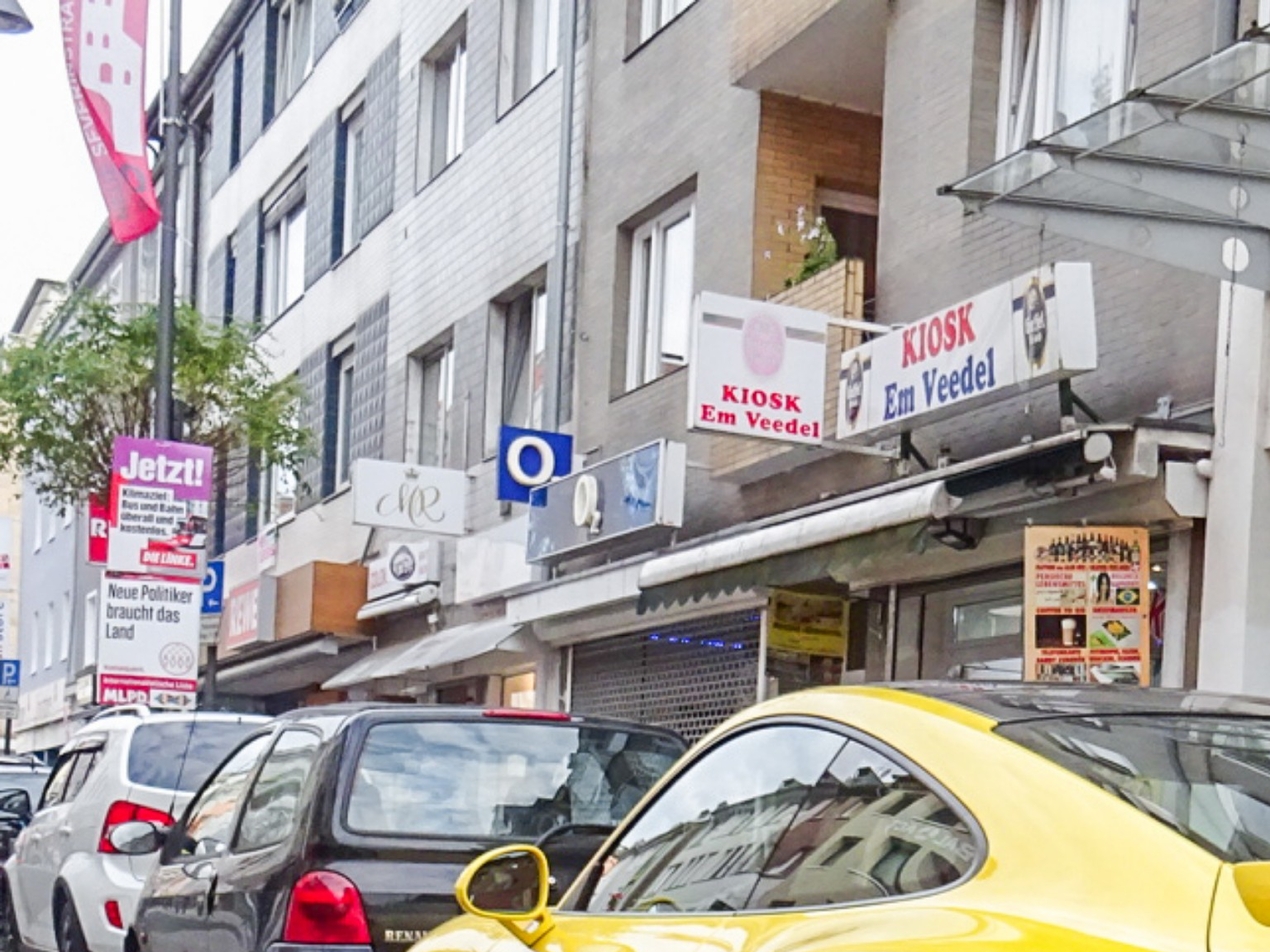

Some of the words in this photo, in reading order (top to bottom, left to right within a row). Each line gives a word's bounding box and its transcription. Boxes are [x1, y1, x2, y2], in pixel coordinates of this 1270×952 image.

[902, 302, 976, 369] KIOSK
[884, 382, 915, 421] Em
[922, 347, 996, 407] Veedel
[722, 384, 802, 413] KIOSK
[701, 404, 736, 425] Em
[746, 410, 820, 438] Veedel
[120, 451, 204, 487] Jetzt!
[122, 499, 139, 511] Bus
[140, 501, 157, 512] und
[160, 502, 184, 514] Bahn
[156, 515, 175, 525] und
[108, 583, 139, 600] Neue
[141, 584, 194, 604] Politiker
[106, 602, 154, 621] braucht
[156, 606, 180, 623] das
[106, 623, 135, 640] Land
[3, 664, 17, 684] P
[103, 687, 149, 704] MLPD
